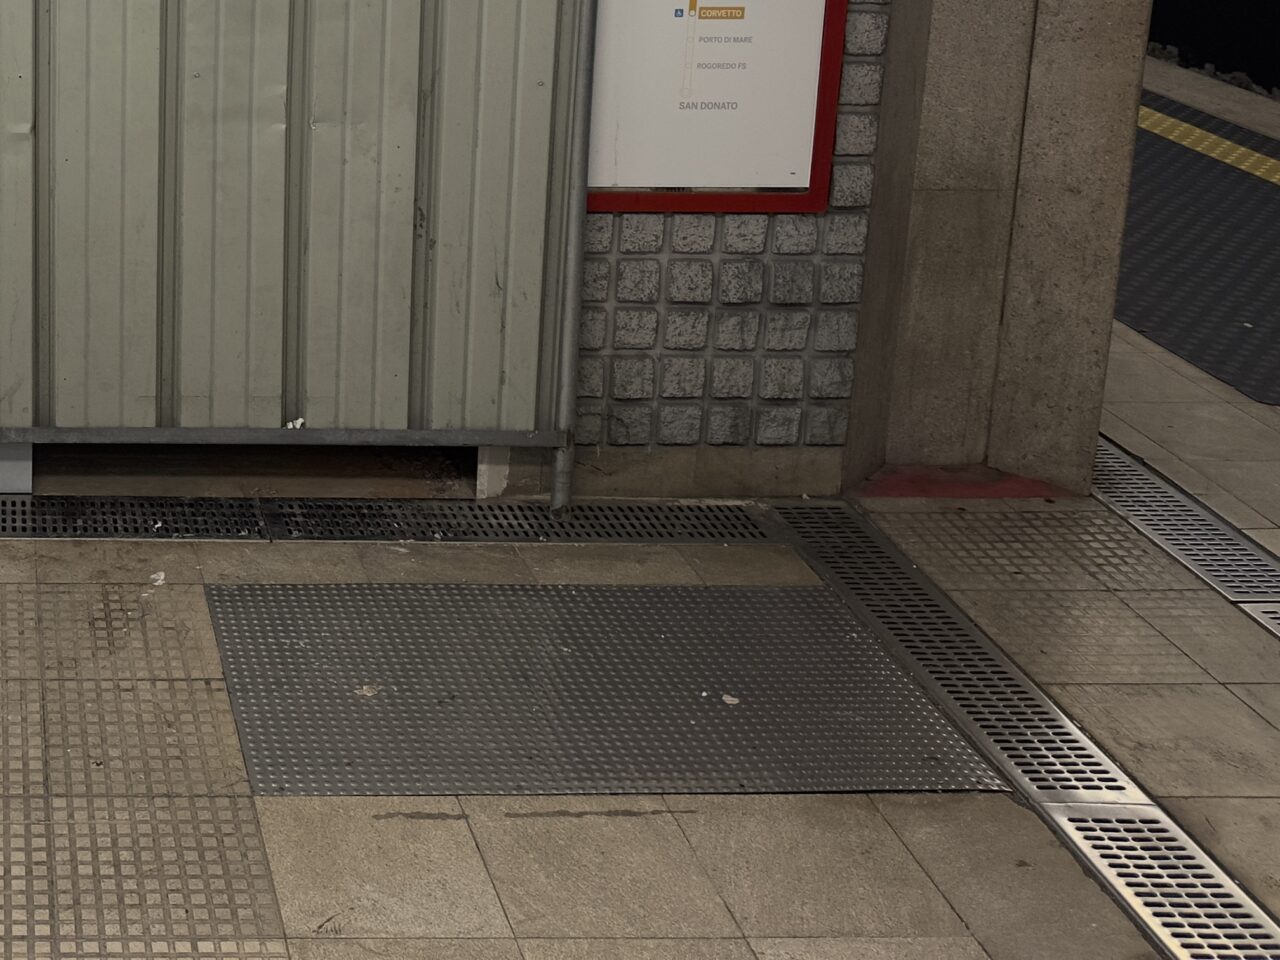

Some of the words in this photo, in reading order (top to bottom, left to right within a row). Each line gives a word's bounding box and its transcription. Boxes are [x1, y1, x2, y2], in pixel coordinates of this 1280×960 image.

[699, 36, 723, 44] PORTO
[724, 36, 731, 44] DI
[732, 36, 753, 44] MARE
[679, 102, 699, 110] SAN
[700, 102, 738, 110] DONATO
